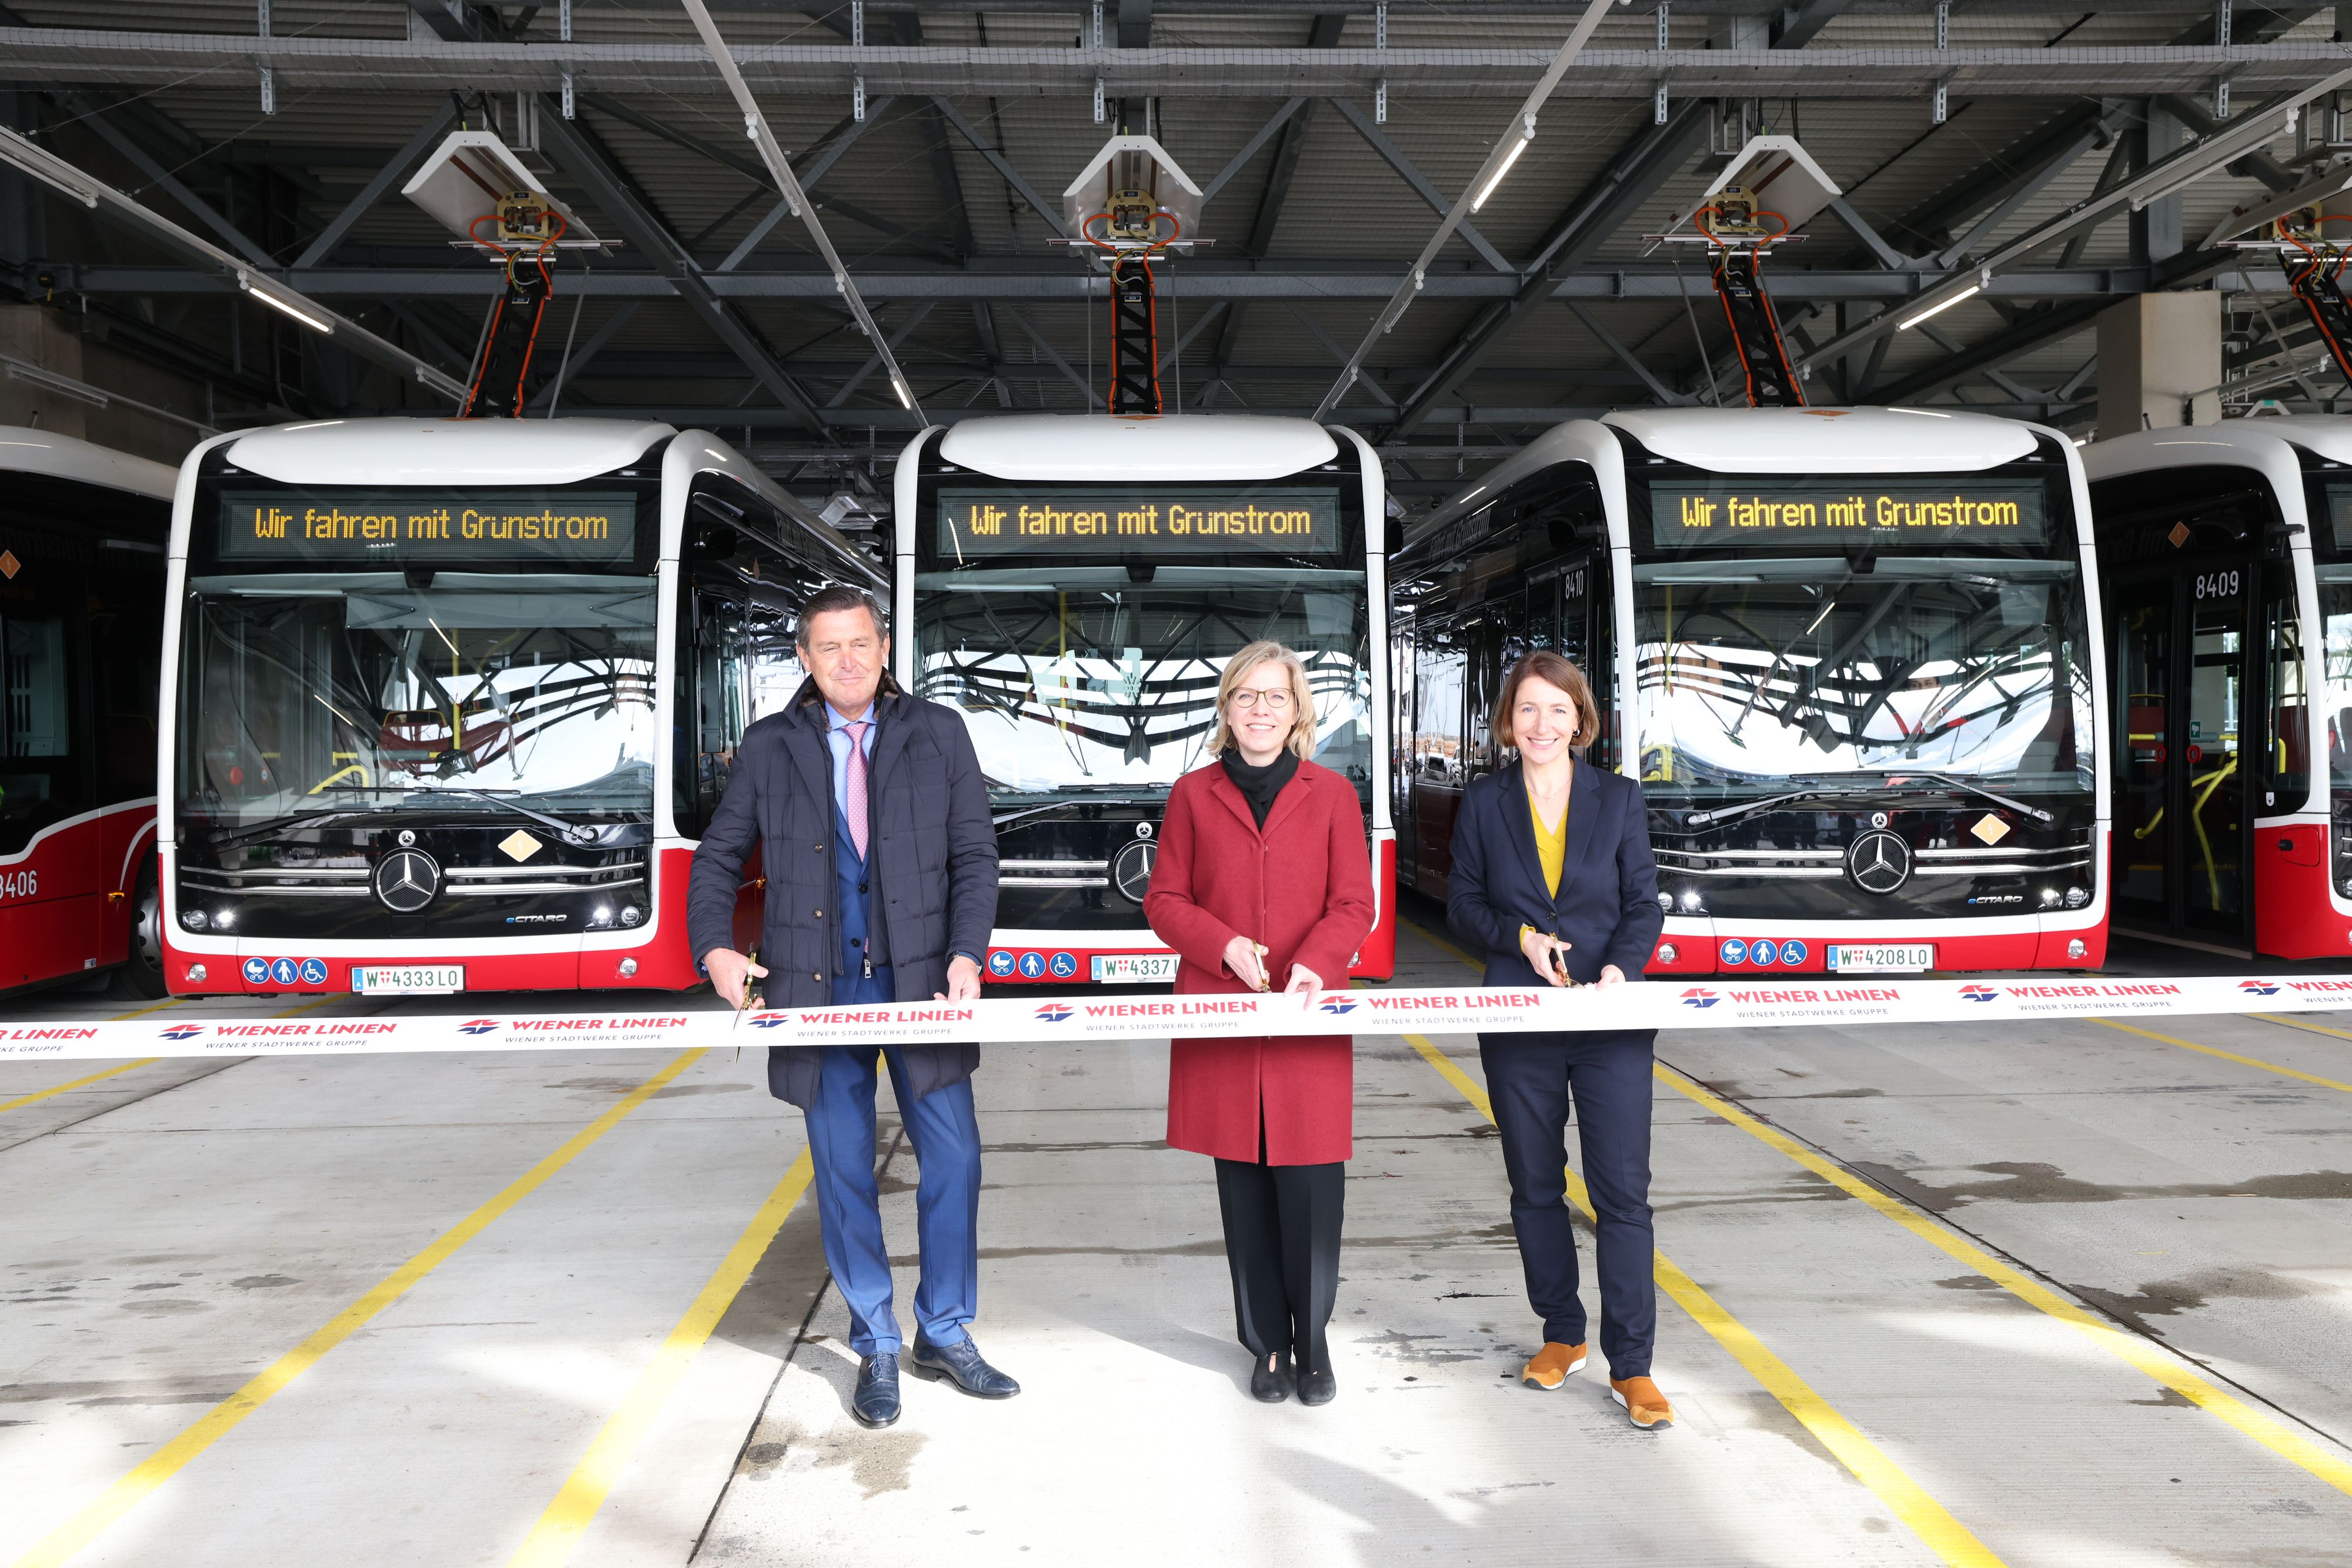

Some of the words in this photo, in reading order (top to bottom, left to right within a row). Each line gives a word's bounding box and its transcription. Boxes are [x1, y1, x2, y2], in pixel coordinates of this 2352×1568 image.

[1682, 497, 1717, 527] Wir
[1728, 497, 1816, 527] fahren
[1826, 497, 1867, 526] mit
[255, 509, 293, 539] Wir
[305, 509, 397, 539] fahren
[408, 510, 450, 539] mit
[971, 506, 1007, 534] Wir
[1018, 506, 1107, 534] fahren
[1118, 506, 1158, 534] mit
[1565, 570, 1583, 600] 8410
[2196, 570, 2239, 600] 8409
[1841, 950, 1852, 965] W
[1105, 960, 1117, 976] W
[366, 972, 378, 987] W
[2285, 981, 2352, 992] WIEN
[1729, 990, 1819, 1003] WIENER
[1824, 989, 1900, 1002] LINIEN
[2006, 986, 2099, 998] WIENER
[2101, 984, 2180, 996] LINIEN
[1085, 1004, 1175, 1017] WIENER
[1182, 1001, 1257, 1014] LINIEN
[1368, 997, 1458, 1009] WIENER
[1464, 994, 1540, 1008] LINIEN
[513, 1019, 603, 1030] WIENER
[609, 1018, 687, 1029] LINIEN
[800, 1012, 891, 1024] WIENER
[897, 1009, 973, 1022] LINIEN
[9, 1028, 99, 1040] LINIEN
[218, 1025, 312, 1037] WIENER
[315, 1024, 397, 1035] LINIEN
